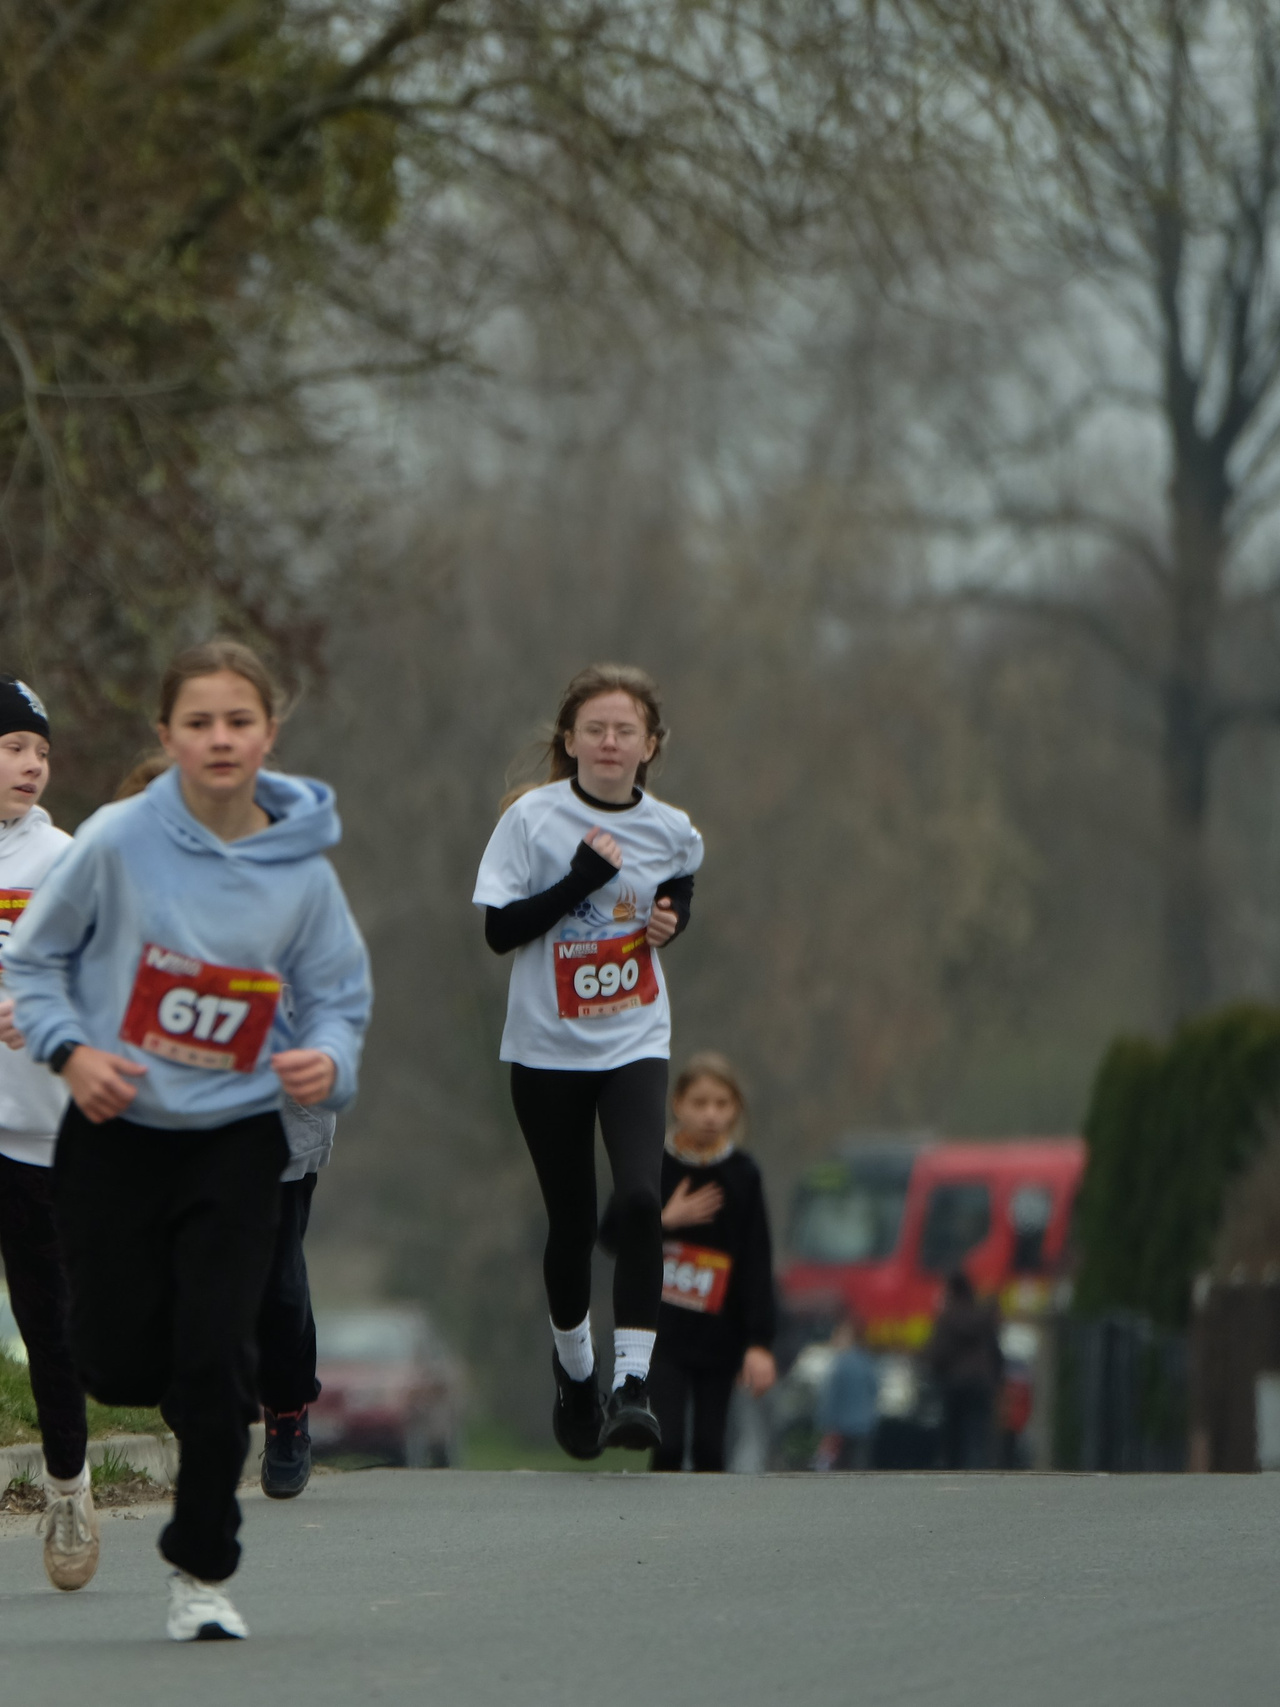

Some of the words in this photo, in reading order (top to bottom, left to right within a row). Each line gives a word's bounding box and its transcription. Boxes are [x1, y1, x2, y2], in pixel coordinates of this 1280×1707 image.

[574, 942, 598, 951] BIEG
[574, 958, 639, 999] 690
[158, 987, 250, 1044] 617
